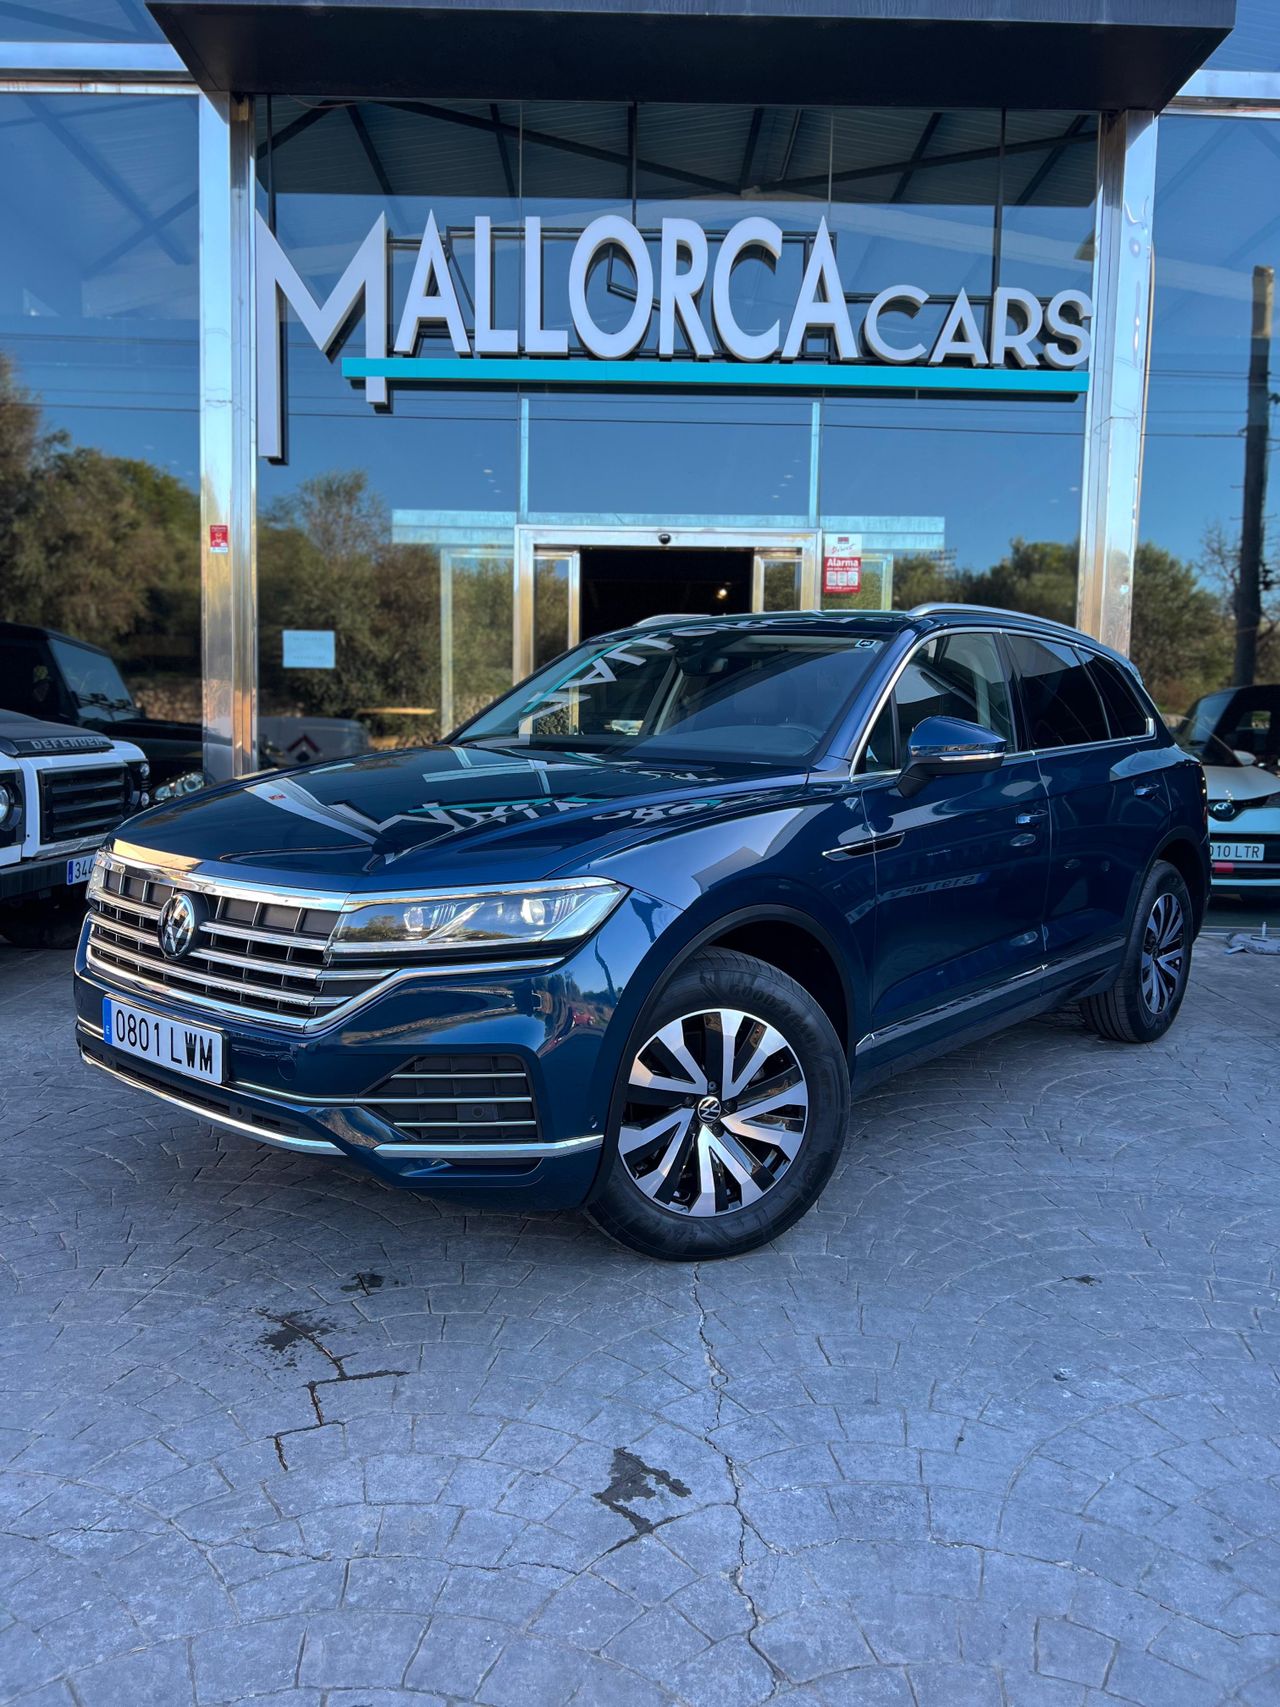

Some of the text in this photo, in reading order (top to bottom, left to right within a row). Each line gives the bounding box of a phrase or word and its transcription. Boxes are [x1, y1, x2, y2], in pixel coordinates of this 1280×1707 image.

[254, 208, 1093, 459] MALLORCA CARS
[826, 557, 859, 567] Alarma
[30, 738, 103, 750] DEFENDER
[1235, 845, 1260, 858] LTR
[116, 1009, 160, 1056] 0801
[170, 1026, 213, 1074] LWM
